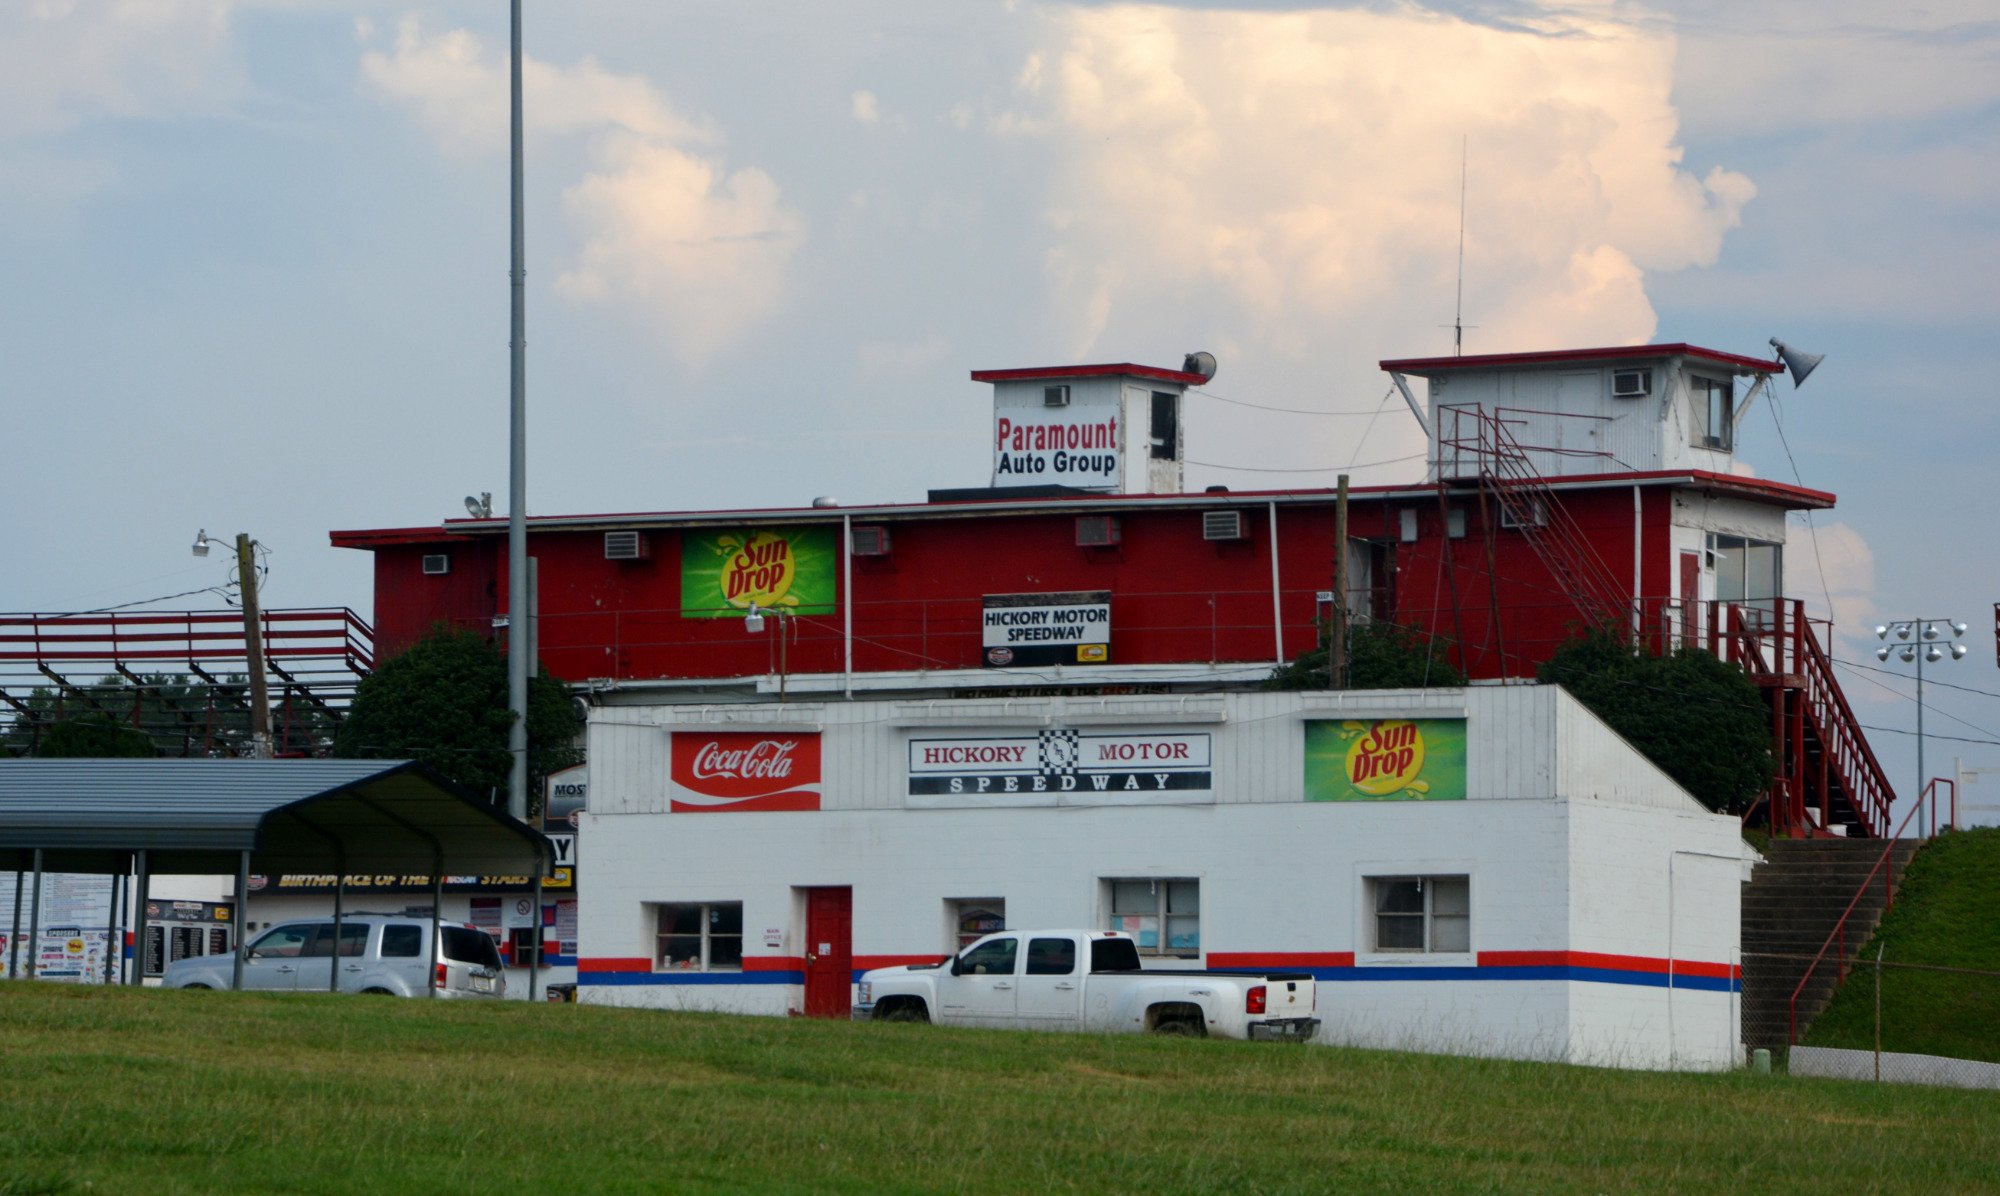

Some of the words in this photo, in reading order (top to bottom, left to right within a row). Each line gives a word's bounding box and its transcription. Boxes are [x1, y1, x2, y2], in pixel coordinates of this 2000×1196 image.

[998, 416, 1116, 451] Paramount
[998, 452, 1045, 474] Auto
[1053, 451, 1116, 476] Group
[735, 536, 788, 570] Sun
[727, 562, 785, 599] Drop
[985, 611, 1049, 626] HICKORY
[1053, 608, 1107, 624] MOTOR
[1008, 626, 1085, 642] SPEEDWAY
[1360, 720, 1417, 754] Sun
[692, 740, 799, 779] Coca-Cola
[924, 746, 1026, 764] HICKORY
[1099, 742, 1189, 760] MOTOR
[1353, 747, 1414, 784] Drop
[553, 784, 587, 796] MOS
[950, 774, 1169, 793] SPEEDWAY
